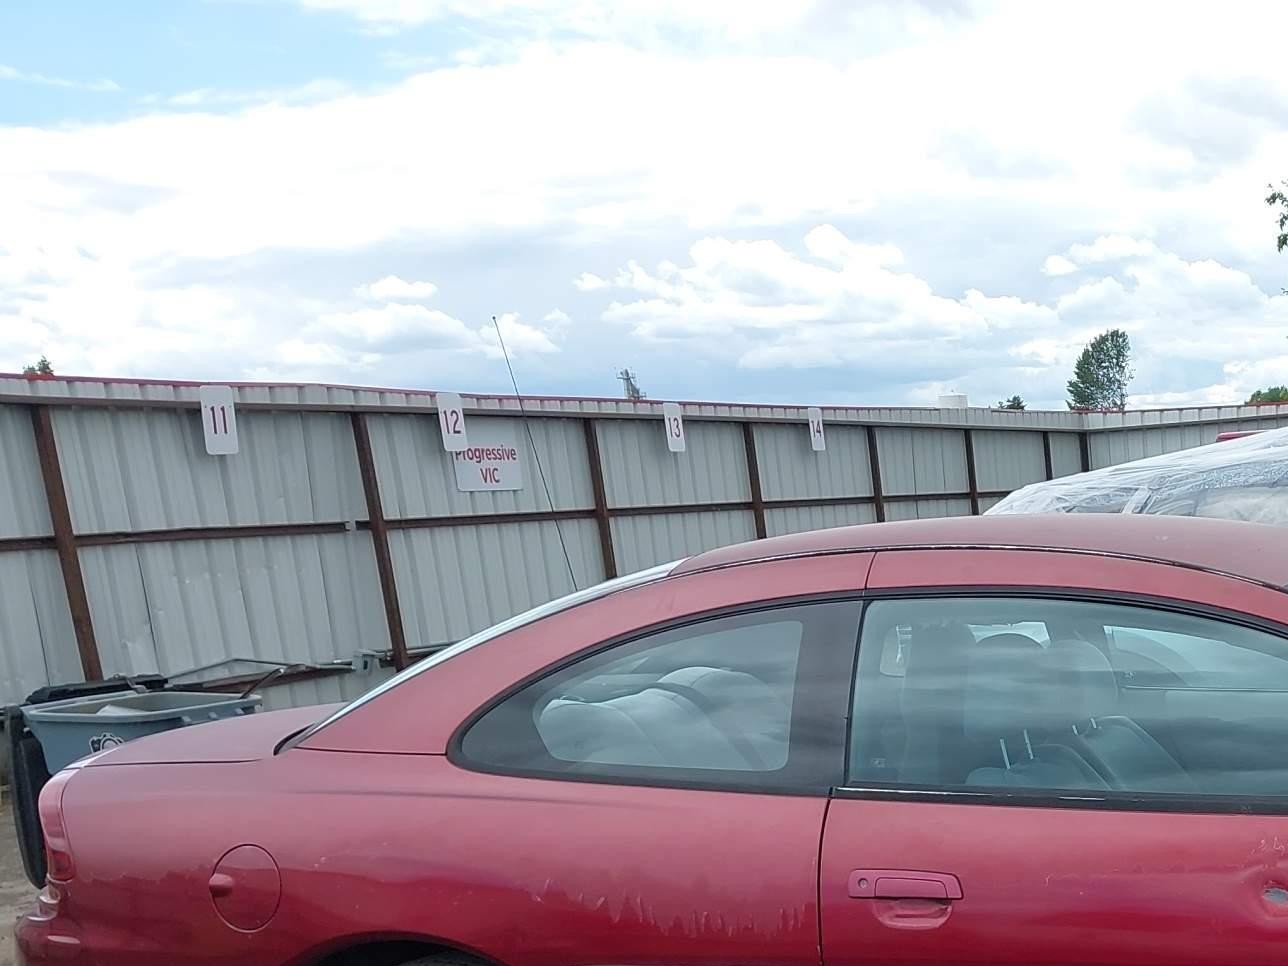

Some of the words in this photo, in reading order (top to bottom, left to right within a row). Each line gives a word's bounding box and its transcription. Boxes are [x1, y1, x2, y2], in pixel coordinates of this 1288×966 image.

[210, 405, 228, 435] 11
[443, 409, 462, 435] 12
[668, 416, 681, 438] 13
[810, 420, 822, 438] 14
[480, 467, 501, 483] VIC
